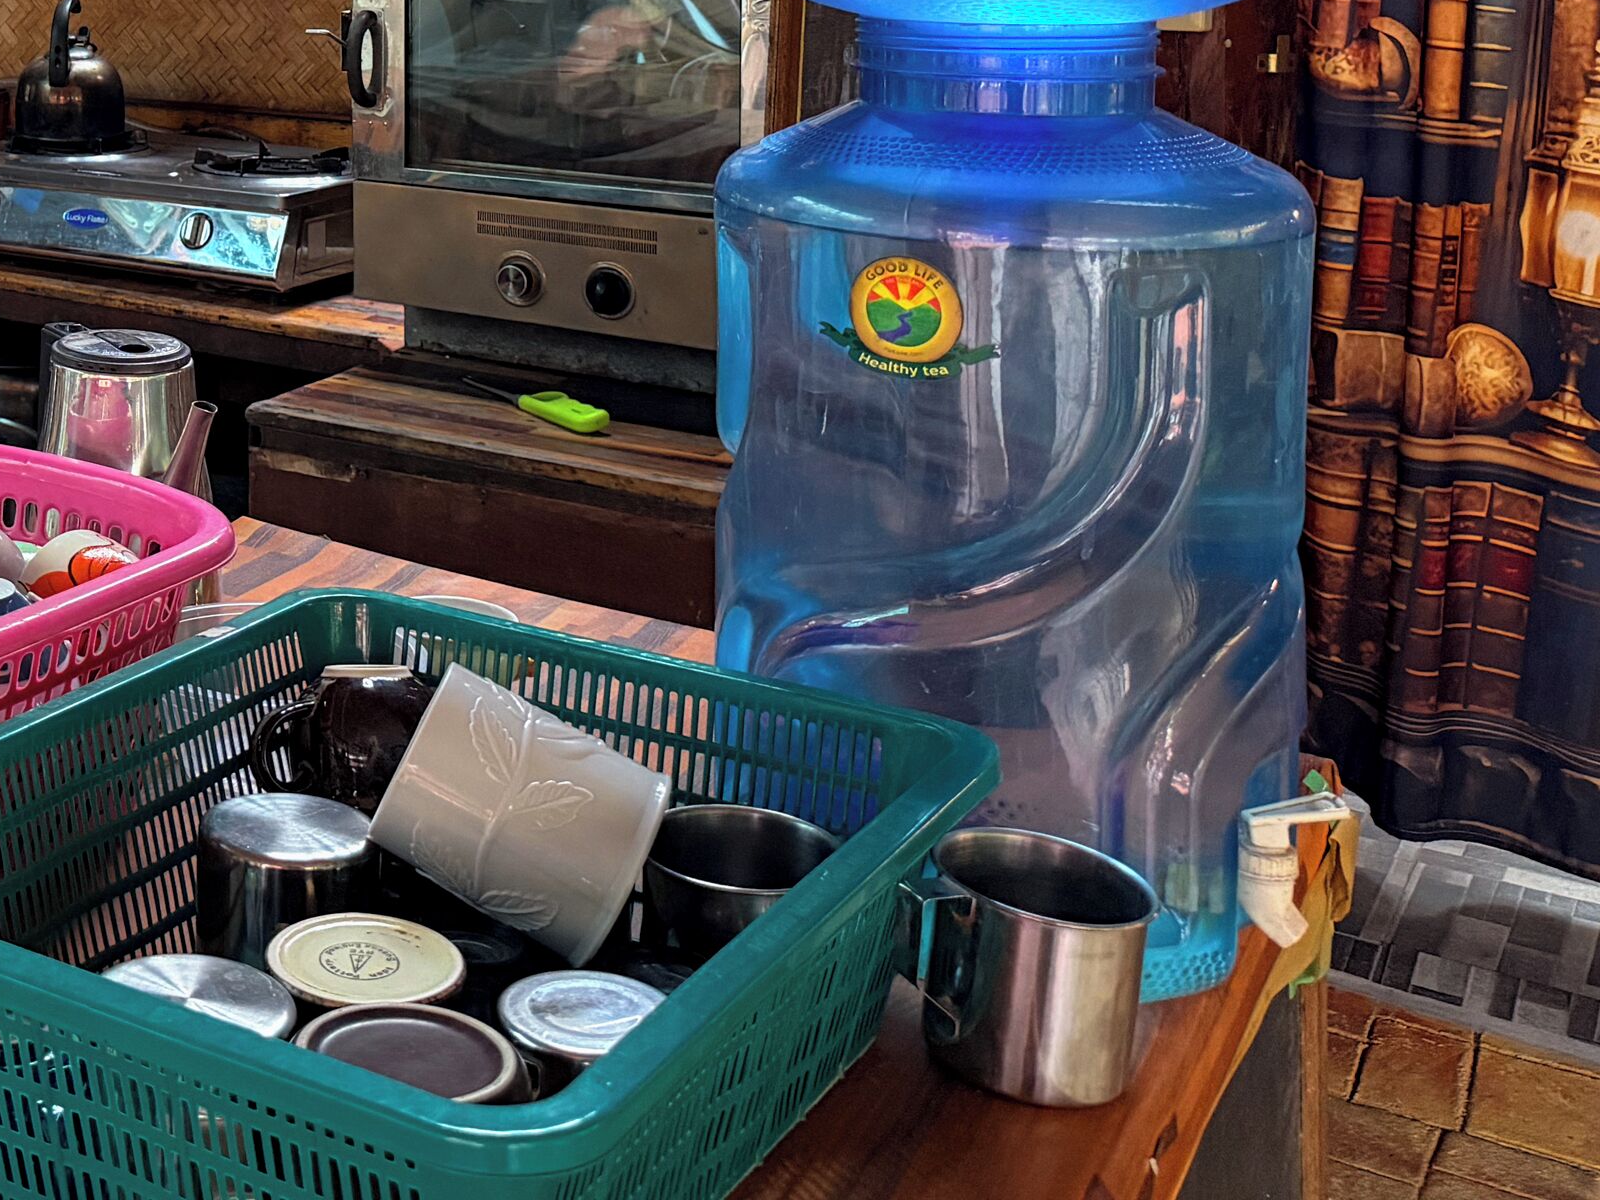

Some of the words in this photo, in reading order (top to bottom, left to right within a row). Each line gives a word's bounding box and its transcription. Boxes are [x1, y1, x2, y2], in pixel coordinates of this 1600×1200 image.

[865, 261, 909, 282] GOOD
[914, 263, 944, 291] LIFE
[858, 351, 918, 378] Healthy
[922, 362, 950, 377] tea
